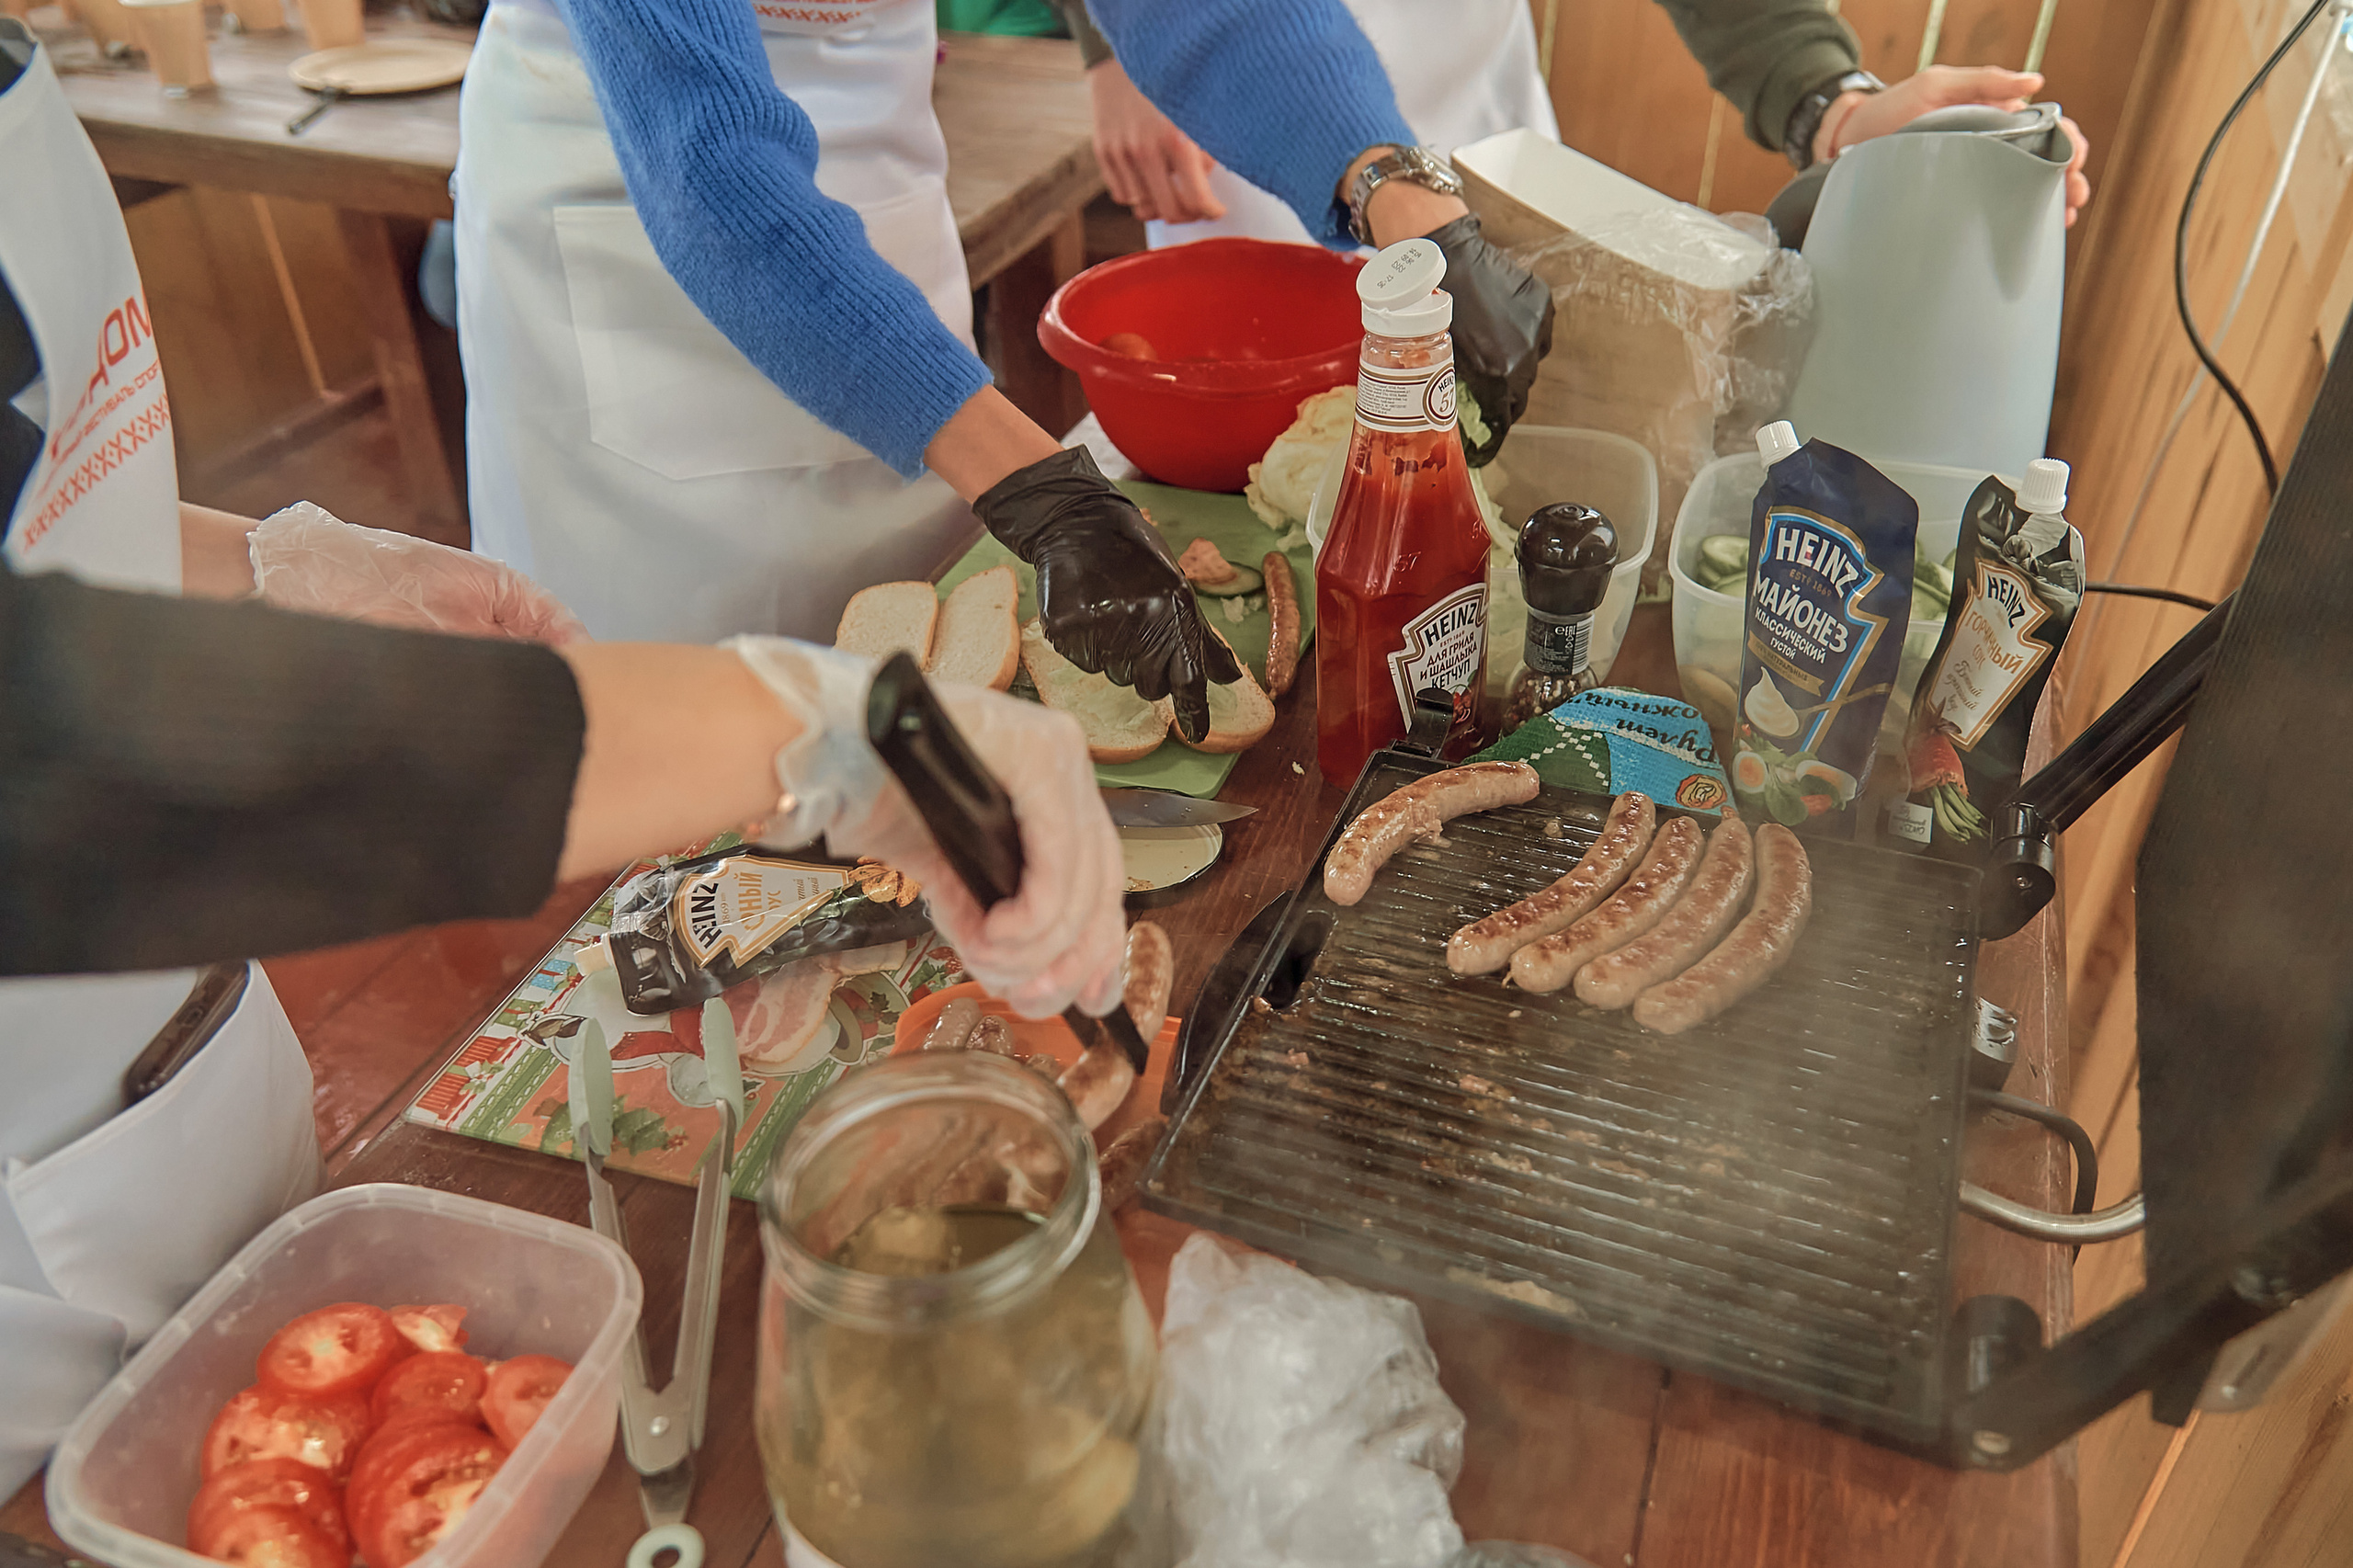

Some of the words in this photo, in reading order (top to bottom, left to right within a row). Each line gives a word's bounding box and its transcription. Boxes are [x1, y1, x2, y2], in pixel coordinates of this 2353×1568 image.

[1776, 527, 1859, 598] HEINZ
[1812, 579, 1833, 597] 1869
[1987, 574, 2026, 629] HEINZ
[1425, 603, 1477, 647] HEINZ
[1754, 571, 1849, 653] МАЙОНЕЗ
[1427, 647, 1448, 667] ДЛЯ
[1449, 631, 1474, 657] ГРИЛЯ
[1756, 607, 1826, 664] КЛАССИЧЕСКИЙ
[1770, 636, 1797, 660] ГУСТОЙ
[1419, 669, 1428, 681] И
[1429, 642, 1477, 677] ШАШЛЫКА
[1431, 659, 1472, 689] КЕТЧУП
[691, 882, 722, 949] HEINZ
